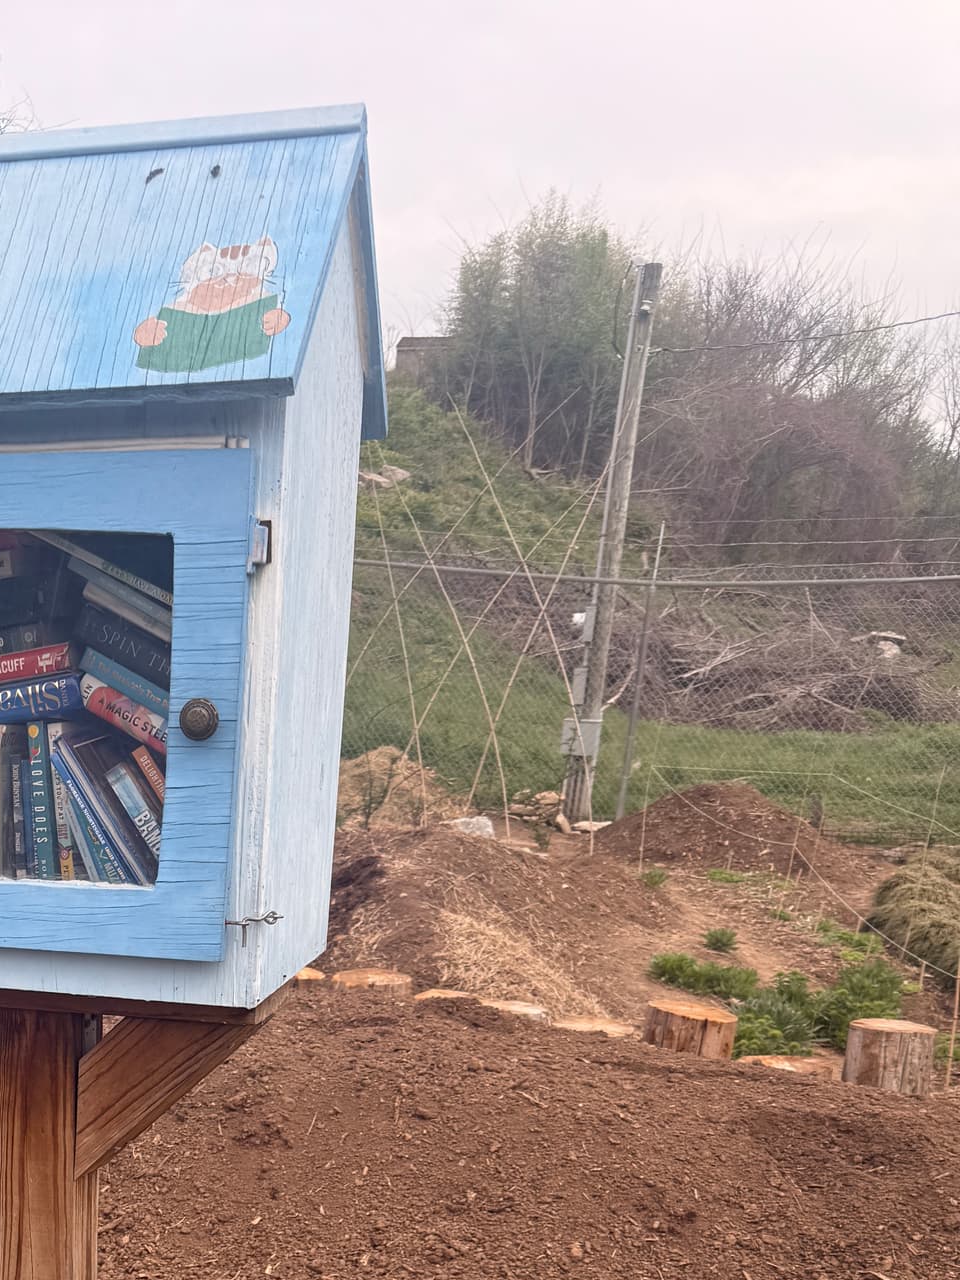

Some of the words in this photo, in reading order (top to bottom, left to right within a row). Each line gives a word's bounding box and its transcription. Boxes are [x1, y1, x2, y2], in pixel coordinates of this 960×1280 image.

[102, 624, 142, 657] SPIN
[106, 703, 141, 727] MAGIC
[30, 759, 45, 797] LOVE
[34, 806, 48, 843] DOES
